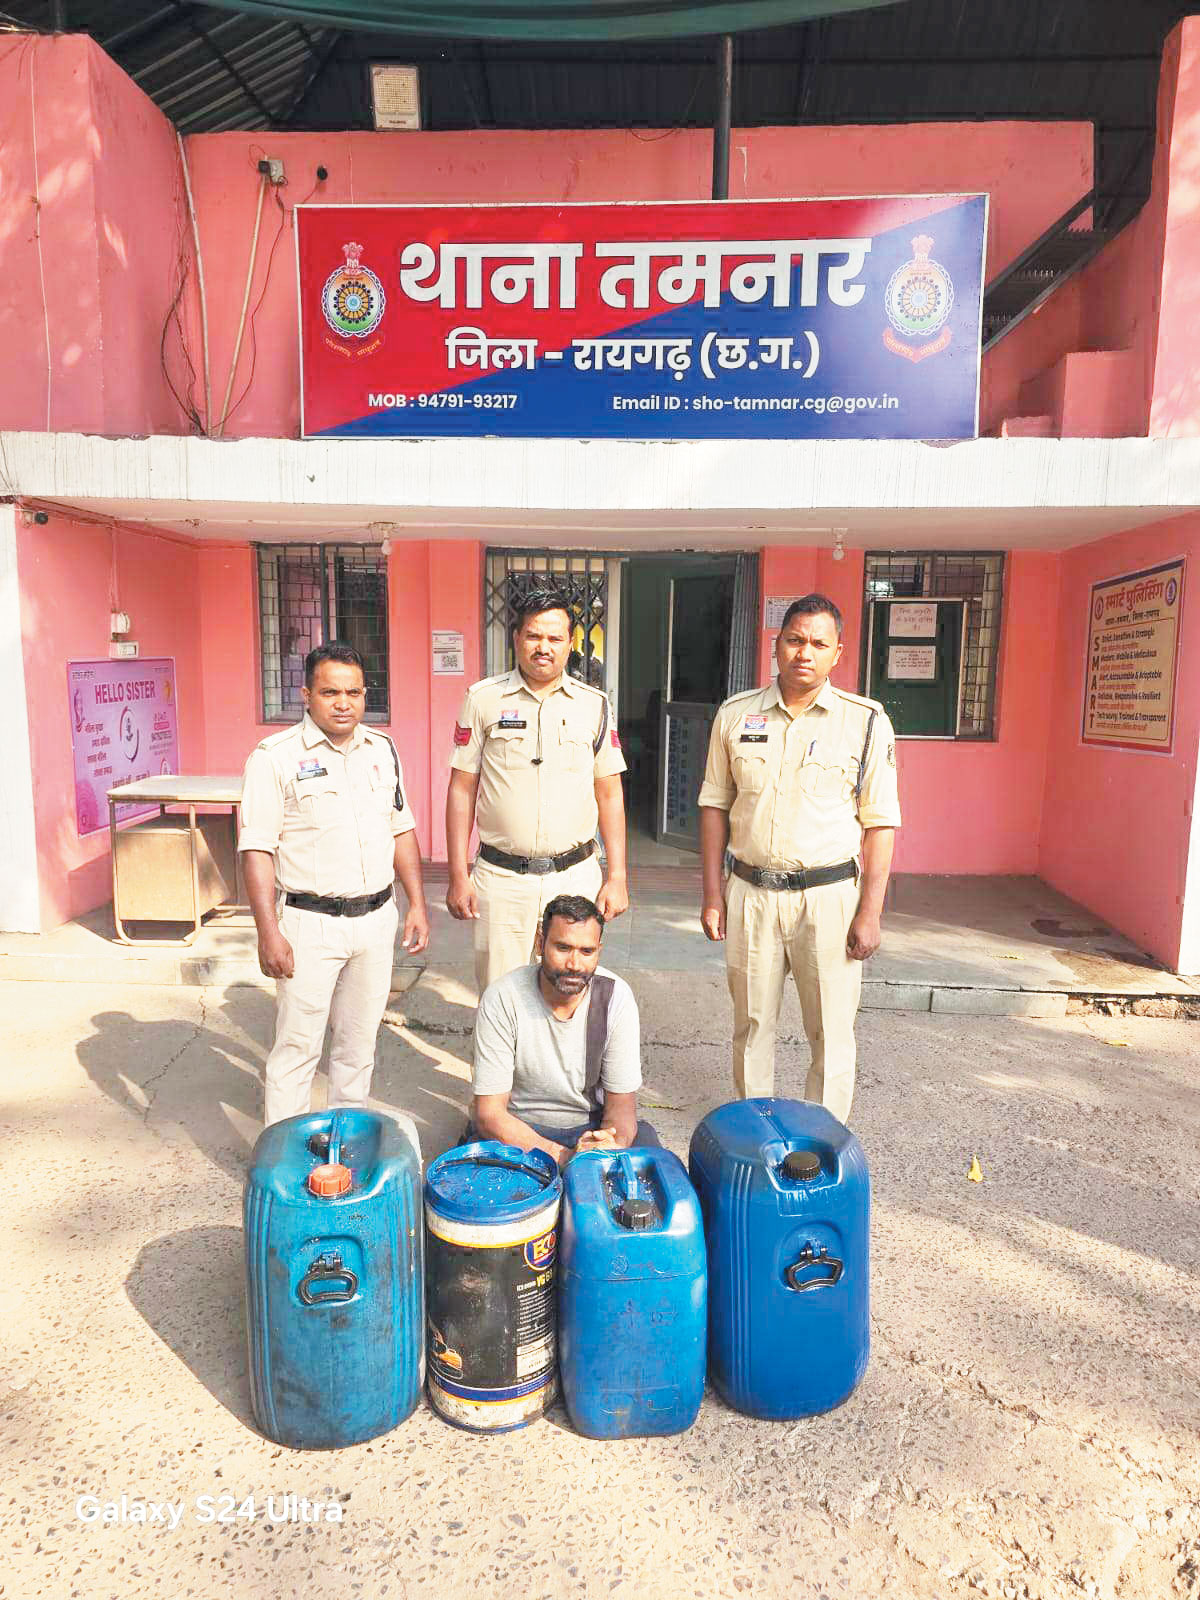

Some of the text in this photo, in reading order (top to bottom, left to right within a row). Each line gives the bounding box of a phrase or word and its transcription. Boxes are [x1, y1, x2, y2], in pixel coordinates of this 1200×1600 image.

[400, 238, 873, 309] थाना तमनार
[445, 326, 538, 371] जिला
[572, 336, 693, 382] रायगढ़
[700, 331, 821, 380] (छ.ग.)
[418, 393, 518, 409] 94791-93217
[613, 395, 660, 410] Email
[693, 393, 899, 414] sho-tamnar.cg@gov.in
[94, 680, 156, 704] HELLO SISTER
